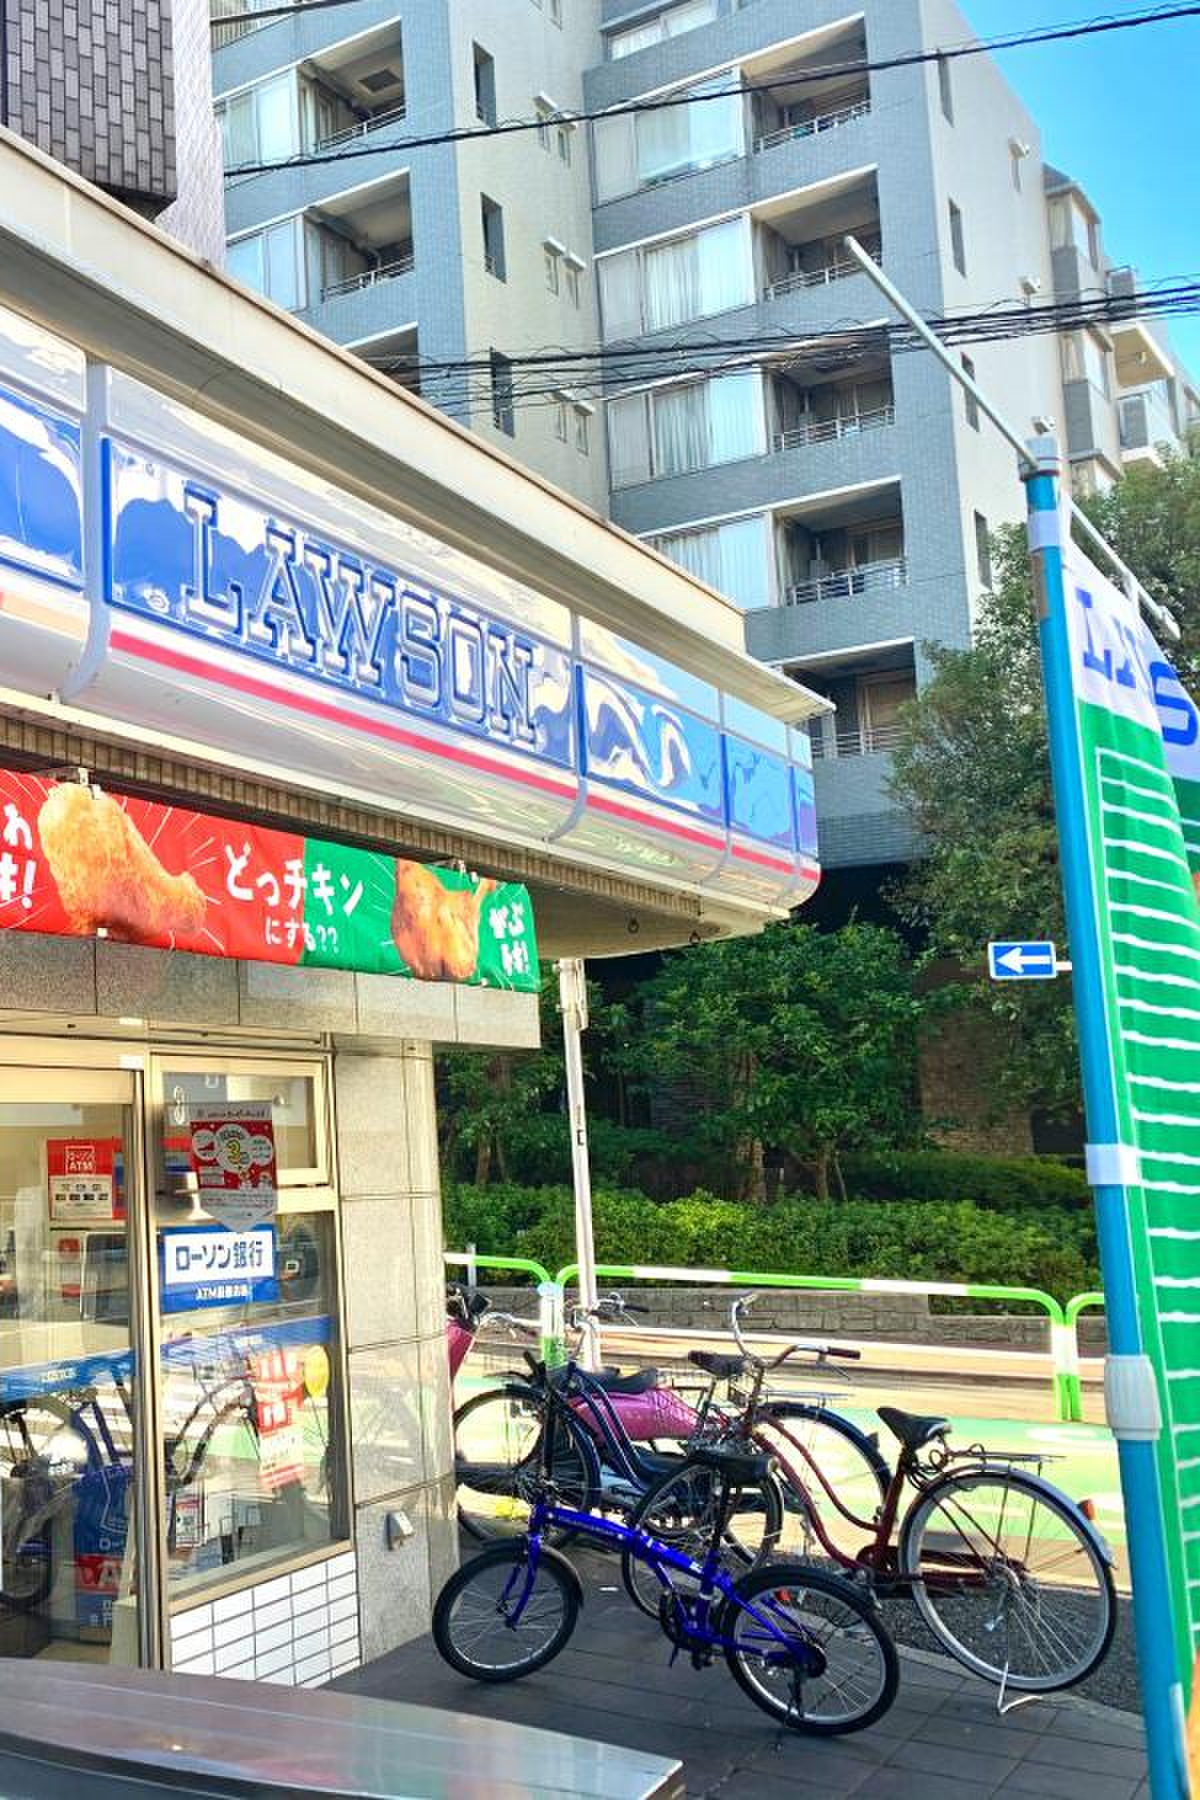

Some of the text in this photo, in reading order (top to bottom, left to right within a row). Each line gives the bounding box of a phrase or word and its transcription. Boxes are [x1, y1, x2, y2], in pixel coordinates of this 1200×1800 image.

[183, 479, 542, 750] LAWSON
[224, 841, 364, 916] どっチキン
[69, 1161, 94, 1171] ATM
[176, 1240, 263, 1271] ローソン銀行
